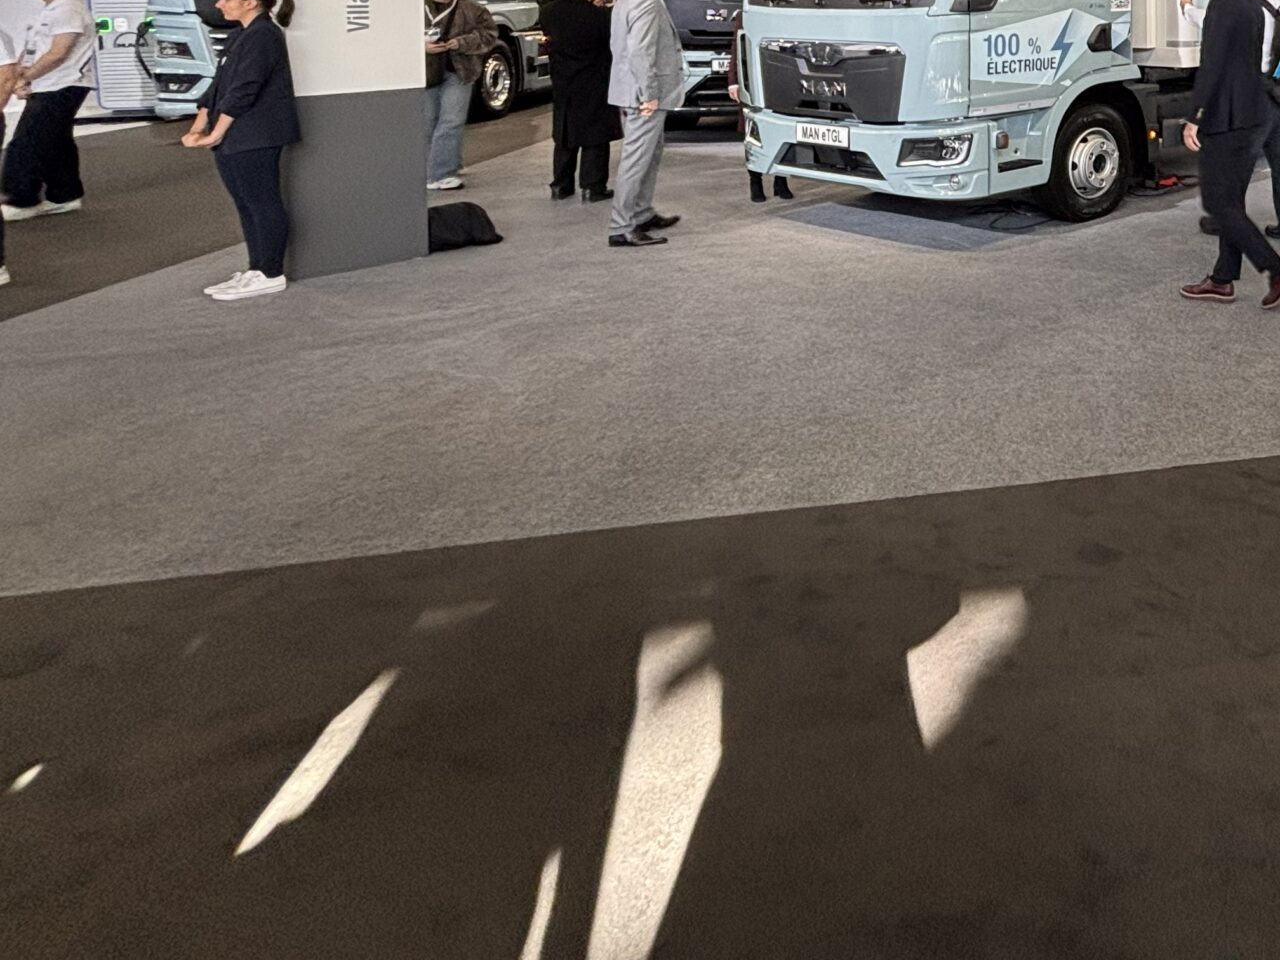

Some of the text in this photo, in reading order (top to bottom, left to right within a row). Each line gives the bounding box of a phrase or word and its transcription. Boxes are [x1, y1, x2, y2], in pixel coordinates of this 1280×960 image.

[983, 33, 1042, 58] 100 %
[987, 57, 1057, 75] ÉLECTRIQUE
[800, 78, 847, 98] MAN
[801, 124, 842, 143] MAN eTGL
